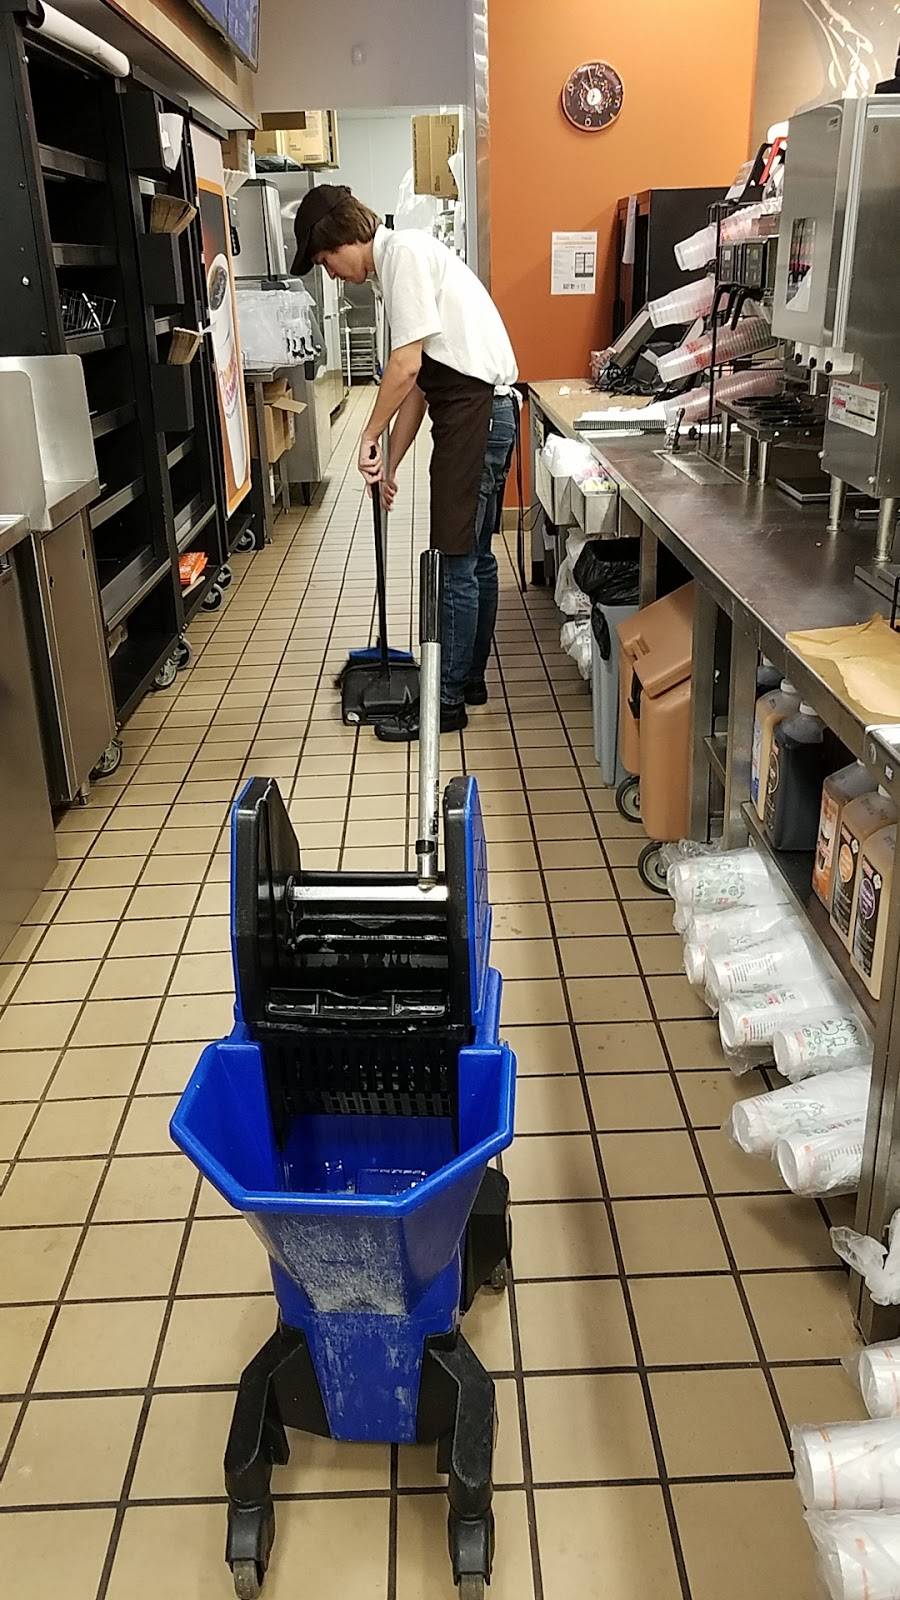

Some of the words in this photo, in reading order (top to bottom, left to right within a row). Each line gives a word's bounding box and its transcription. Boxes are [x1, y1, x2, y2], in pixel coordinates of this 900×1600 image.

[595, 64, 606, 77] 12
[568, 83, 574, 97] 9
[613, 97, 621, 108] 3
[585, 114, 592, 126] 6
